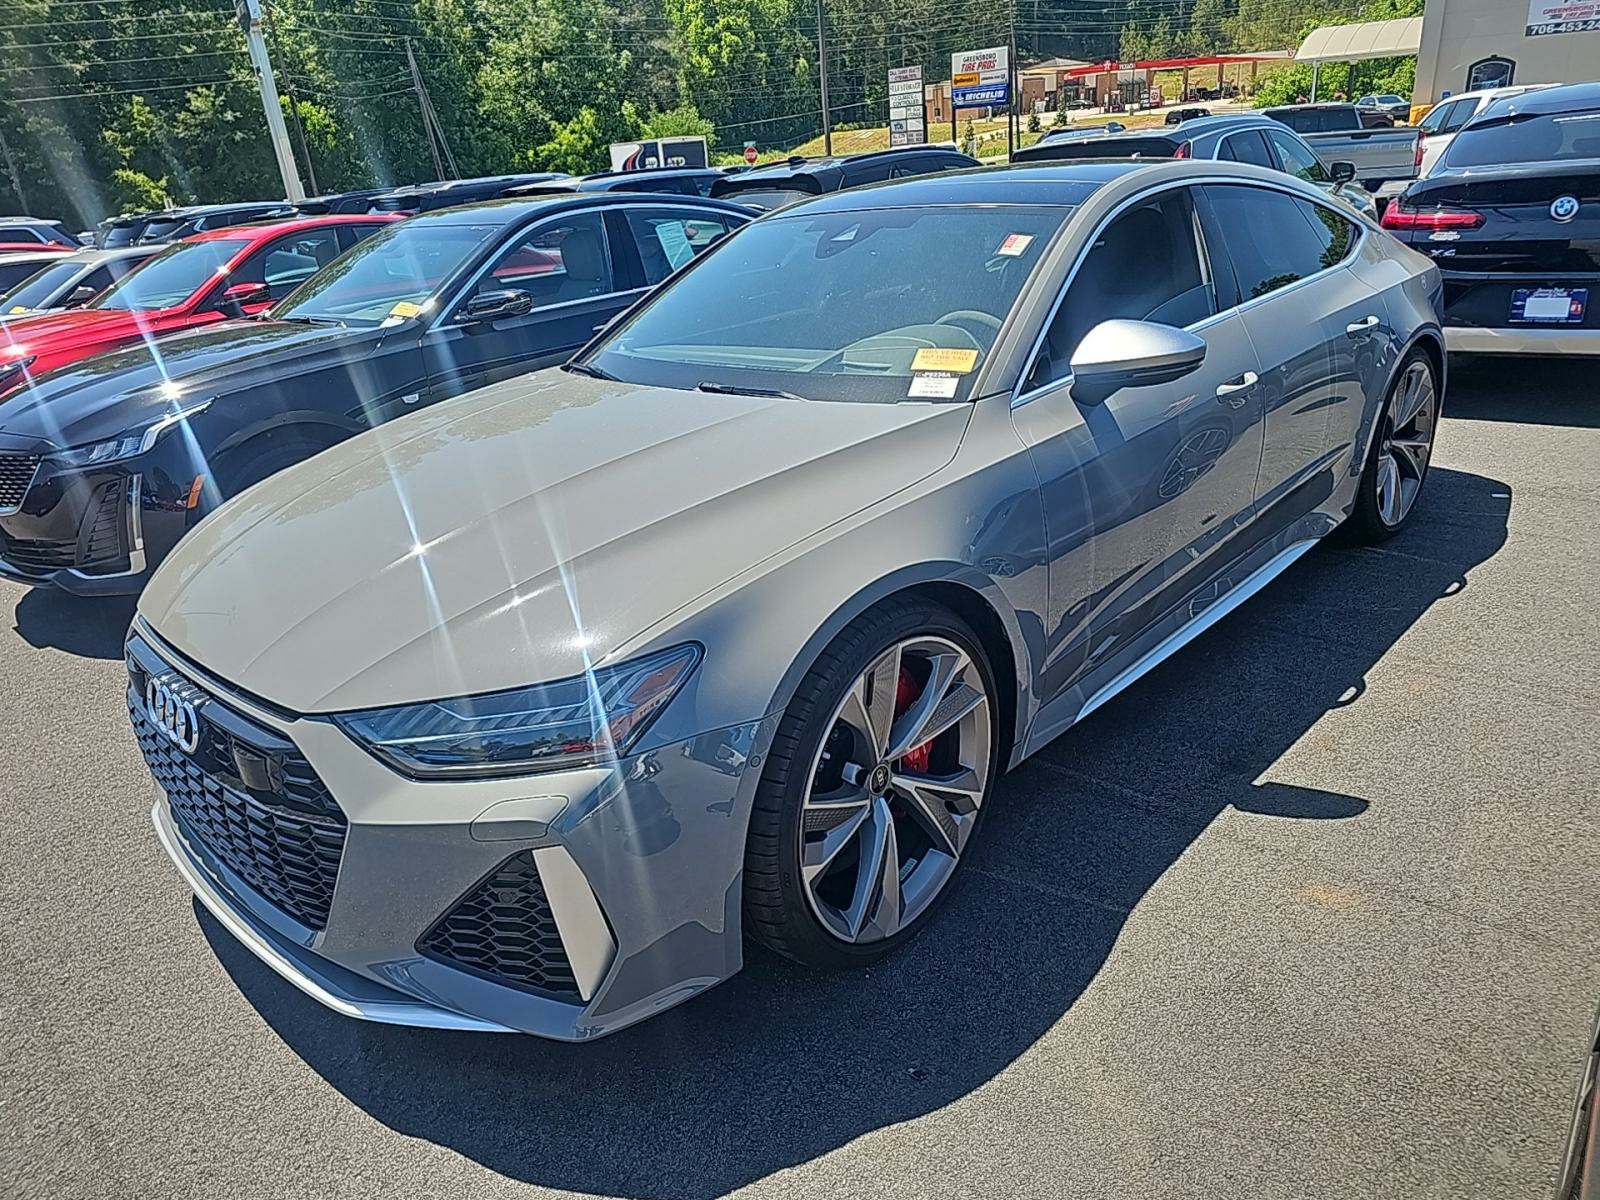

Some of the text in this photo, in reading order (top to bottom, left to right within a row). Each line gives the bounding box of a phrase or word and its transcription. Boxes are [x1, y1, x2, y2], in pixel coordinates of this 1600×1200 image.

[1543, 5, 1594, 15] GREENSBORO
[961, 62, 977, 72] TIRE
[965, 90, 1005, 101] MICHELIN
